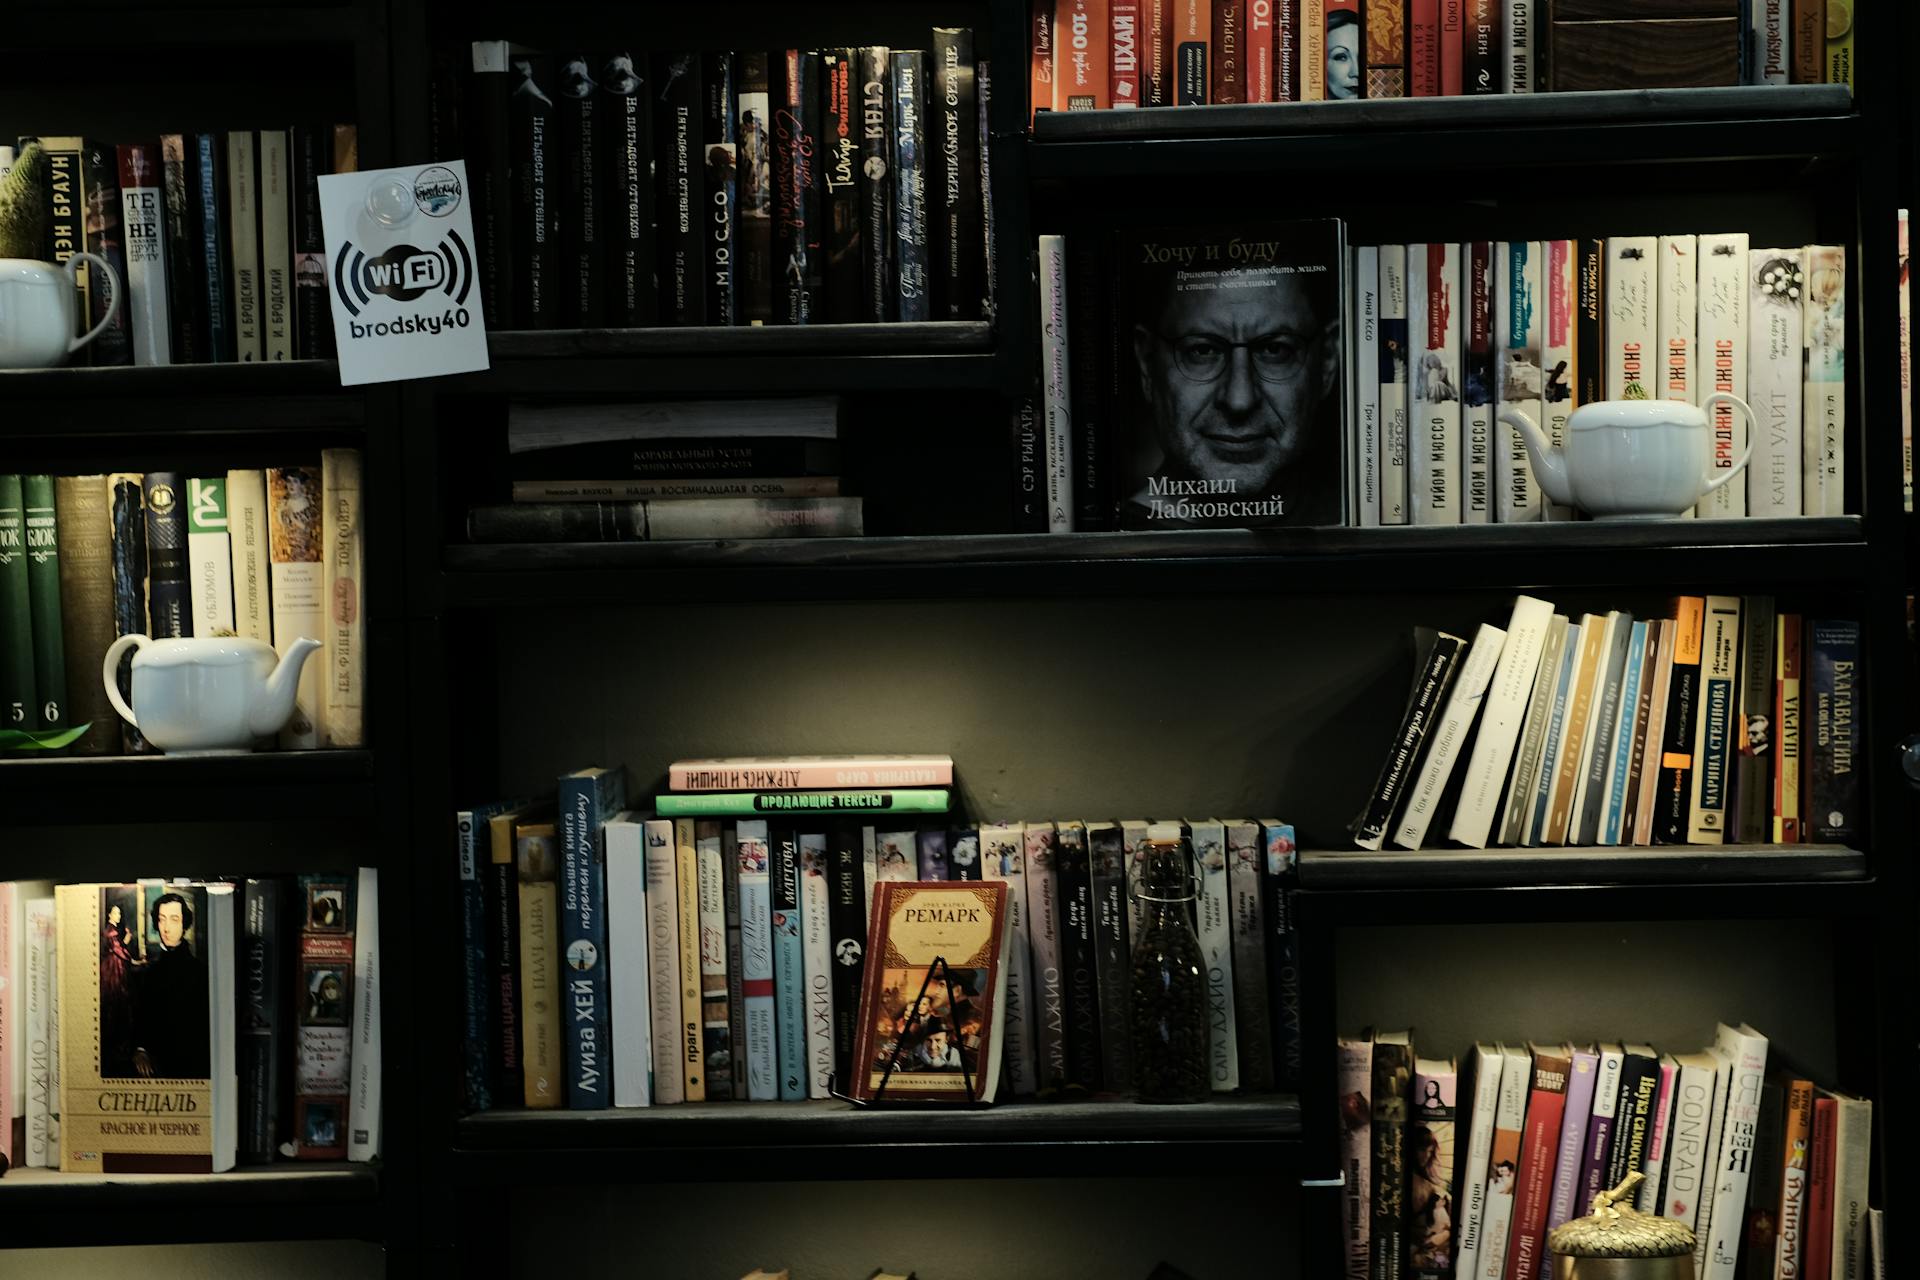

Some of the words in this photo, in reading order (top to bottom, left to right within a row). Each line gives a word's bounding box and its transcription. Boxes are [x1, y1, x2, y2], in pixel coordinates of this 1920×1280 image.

[1072, 13, 1088, 48] 100
[1114, 16, 1136, 71] ЦХАЙ
[1512, 3, 1526, 48] МЮССО
[1800, 11, 1818, 63] Харпер
[898, 68, 914, 103] Твен
[945, 45, 959, 106] СЕРДЦЕ
[626, 96, 638, 115] На
[836, 60, 849, 138] Филатова
[864, 81, 884, 139] СТАЯ
[677, 106, 689, 174] Пятьдесят
[796, 133, 815, 158] 50
[898, 103, 918, 147] Марк
[533, 116, 545, 186] Пятьдесят
[580, 120, 593, 186] пятьдесят
[626, 116, 639, 182] пятьдесят
[825, 137, 859, 194] Театр
[943, 110, 960, 208] ЧЕРНИЛЬНОЕ
[51, 156, 73, 217] БРАУН
[127, 193, 154, 209] ТЕ
[678, 177, 690, 234] оттенков
[129, 223, 156, 238] НЕ
[534, 188, 545, 243] оттенков
[581, 187, 594, 243] оттенков
[627, 182, 640, 240] оттенков
[53, 224, 75, 262] ДЭН
[714, 191, 730, 286] МЮССО
[1143, 243, 1196, 266] Хочу
[1205, 244, 1221, 260] и
[1228, 239, 1280, 266] буду
[1176, 269, 1219, 281] Принять
[1242, 265, 1295, 278] полюбить
[1297, 263, 1327, 274] жизнь
[1588, 253, 1598, 290] КРИСТИ
[239, 269, 254, 324] БРОДСКИЙ
[270, 269, 284, 324] БРОДСКИЙ
[1365, 291, 1374, 315] Анна
[1589, 290, 1598, 321] АГАТА
[350, 307, 470, 339] brodsky40
[1669, 338, 1687, 391] ДЖОНС
[1715, 339, 1732, 393] ДЖОНС
[1021, 405, 1036, 463] РЫЦАРЬ
[1364, 403, 1374, 422] Три
[1770, 390, 1787, 447] УАЙТ
[1827, 395, 1836, 474] ДЖУЭЛЛ
[1364, 423, 1373, 454] жизни
[1430, 417, 1444, 463] МЮССО
[1471, 420, 1486, 464] МЮССО
[625, 485, 655, 497] НАША
[660, 484, 748, 497] ВОСЕМНАДЦАТАЯ
[752, 484, 785, 496] ОСЕНЬ
[1020, 467, 1035, 492] СЭР
[1147, 477, 1237, 495] Михаил
[1363, 457, 1374, 503] женщины
[1431, 468, 1445, 509] ГИЙОМ
[1471, 470, 1486, 511] ГИЙОМ
[1512, 470, 1527, 508] ГИЙОМ
[1772, 455, 1786, 506] КАРЕН
[338, 499, 351, 539] СОЙЕР
[1146, 494, 1284, 519] Лабковский
[27, 528, 56, 546] БЛОК
[338, 541, 350, 567] ТОМ
[206, 561, 217, 620] ОБЛОМОВ
[1711, 619, 1723, 675] Женщины
[1751, 618, 1765, 692] ПРОЦЕСС
[1679, 673, 1691, 700] Дюма
[13, 702, 25, 722] 5
[45, 701, 60, 722] 6
[1403, 710, 1425, 748] ОСОБЫЕ
[1676, 701, 1690, 748] Александр
[1708, 682, 1727, 751] СТЕПНОВА
[1784, 696, 1798, 759] ШАРМА
[1381, 749, 1409, 802] ПОРУЧЕНИЯ
[1413, 796, 1427, 815] Как
[1423, 763, 1439, 796] кошка
[1439, 720, 1459, 758] собакой
[1705, 754, 1721, 807] МАРИНА
[760, 794, 836, 808] ПРОДАЮЩИЕ
[838, 793, 883, 807] ТЕКСТЫ
[1671, 768, 1684, 818] pocketbook
[563, 812, 576, 850] книга
[575, 792, 591, 857] лучшему
[565, 852, 577, 910] Большая
[782, 841, 795, 905] МАРТОВА
[531, 898, 544, 940] ЛЬВА
[579, 868, 592, 930] перемен
[905, 908, 981, 923] РЕМАРК
[533, 945, 546, 991] ПЛАЧ
[655, 901, 673, 1021] МИХАЛКОВА
[500, 973, 514, 1025] ЦАРЕВА
[571, 979, 595, 1022] ХЕЙ
[813, 975, 830, 1040] ДЖИО
[1044, 967, 1063, 1033] ДЖИО
[1073, 968, 1091, 1033] ДЖИО
[1106, 968, 1124, 1033] ДЖИО
[1207, 967, 1226, 1034] ДЖИО
[1279, 966, 1299, 1033] ДЖИО
[503, 1025, 516, 1069] МАША
[685, 1022, 699, 1064] прага
[749, 1009, 759, 1054] ПИЛЮЛИ
[31, 1039, 49, 1108] ДЖИО
[577, 1028, 599, 1093] Луиза
[815, 1046, 831, 1089] САРА
[1009, 1032, 1021, 1084] КАРЕН
[1214, 1040, 1229, 1082] САРА
[1536, 1070, 1565, 1083] TRAVEL
[98, 1092, 196, 1115] СТЕНДАЛЬ
[1537, 1080, 1562, 1092] STORY
[1633, 1075, 1656, 1115] Наука
[1736, 1073, 1760, 1105] Я
[32, 1124, 47, 1155] САРА
[100, 1122, 147, 1137] КРАСНОЕ
[149, 1122, 157, 1136] И
[159, 1121, 200, 1136] ЧЕРНОЕ
[1673, 1084, 1703, 1192] CONRAD
[1728, 1149, 1749, 1173] Я
[1463, 1214, 1479, 1250] Минус
[1471, 1183, 1482, 1211] один
[1780, 1176, 1800, 1280] ЕЛЬСИНКИ
[1849, 1201, 1858, 1228] ОКНО
